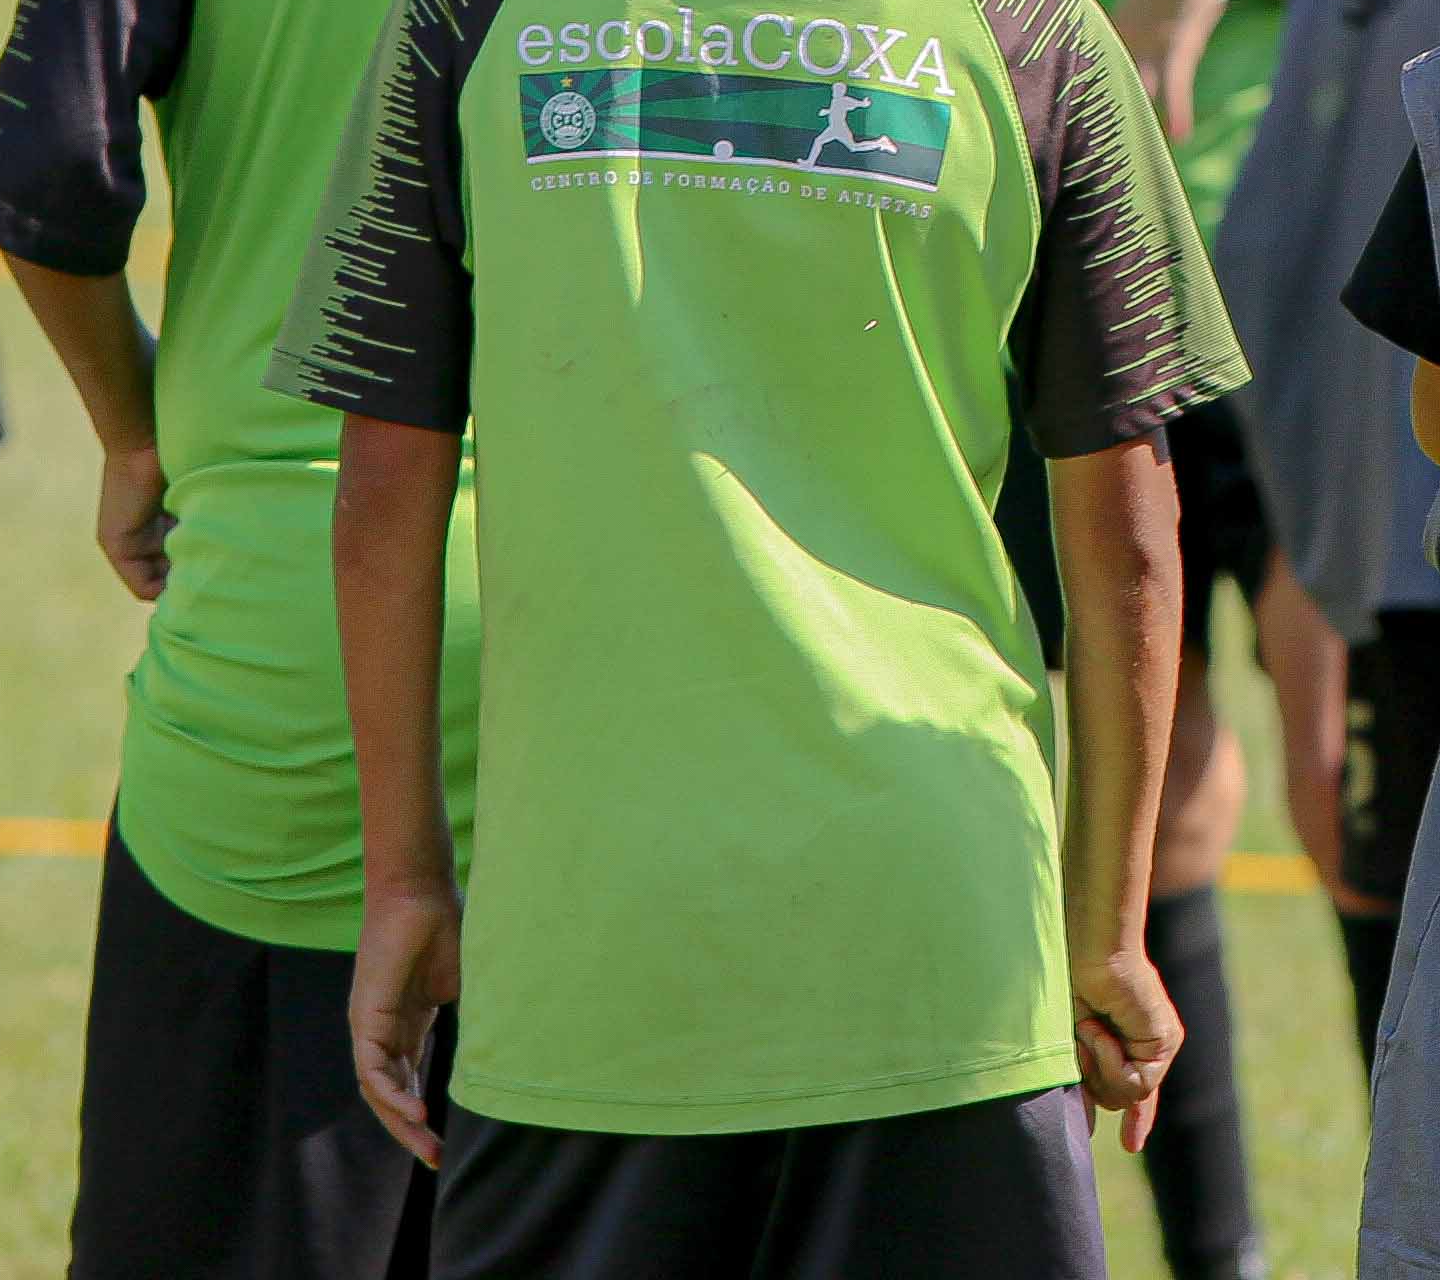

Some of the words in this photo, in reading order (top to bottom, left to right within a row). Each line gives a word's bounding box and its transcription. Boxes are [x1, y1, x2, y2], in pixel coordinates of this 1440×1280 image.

[517, 6, 956, 97] escolaCOXA
[531, 169, 619, 192] CENTRO
[627, 170, 653, 185] DE
[799, 184, 828, 201] DE
[837, 190, 933, 220] ATLETAS
